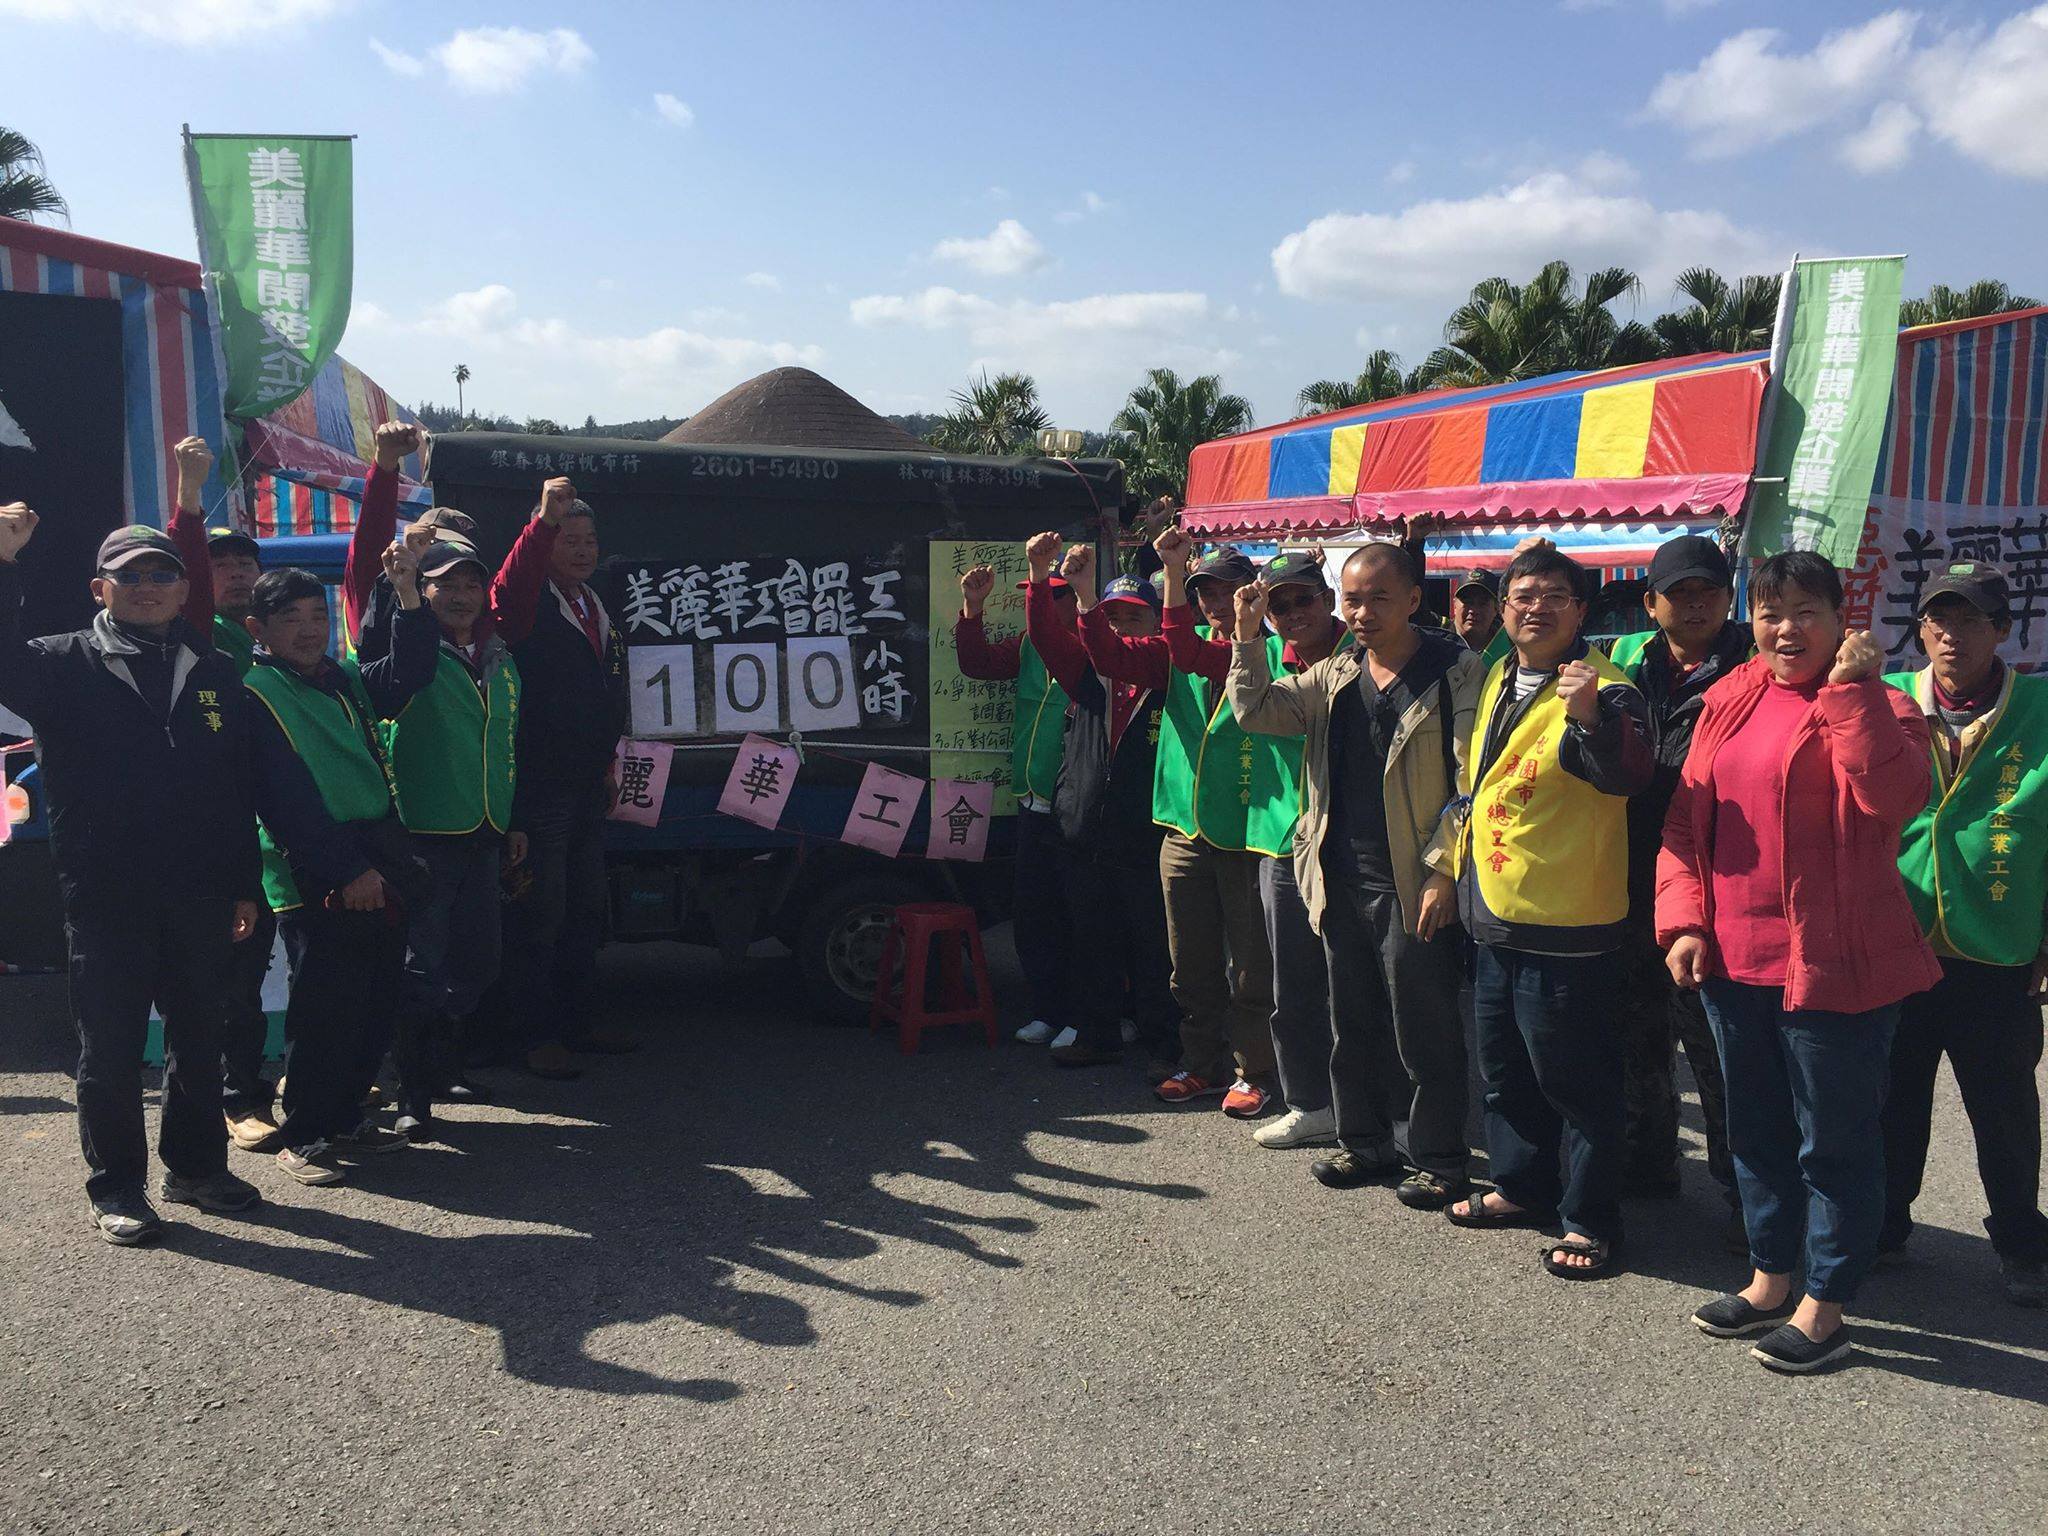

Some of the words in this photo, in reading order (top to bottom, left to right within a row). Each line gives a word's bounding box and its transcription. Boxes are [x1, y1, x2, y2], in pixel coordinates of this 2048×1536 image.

[691, 454, 838, 479] 2601-5490
[863, 640, 910, 714] 小時
[197, 689, 223, 732] 理事
[1988, 741, 2024, 902] 美麗華企業工會
